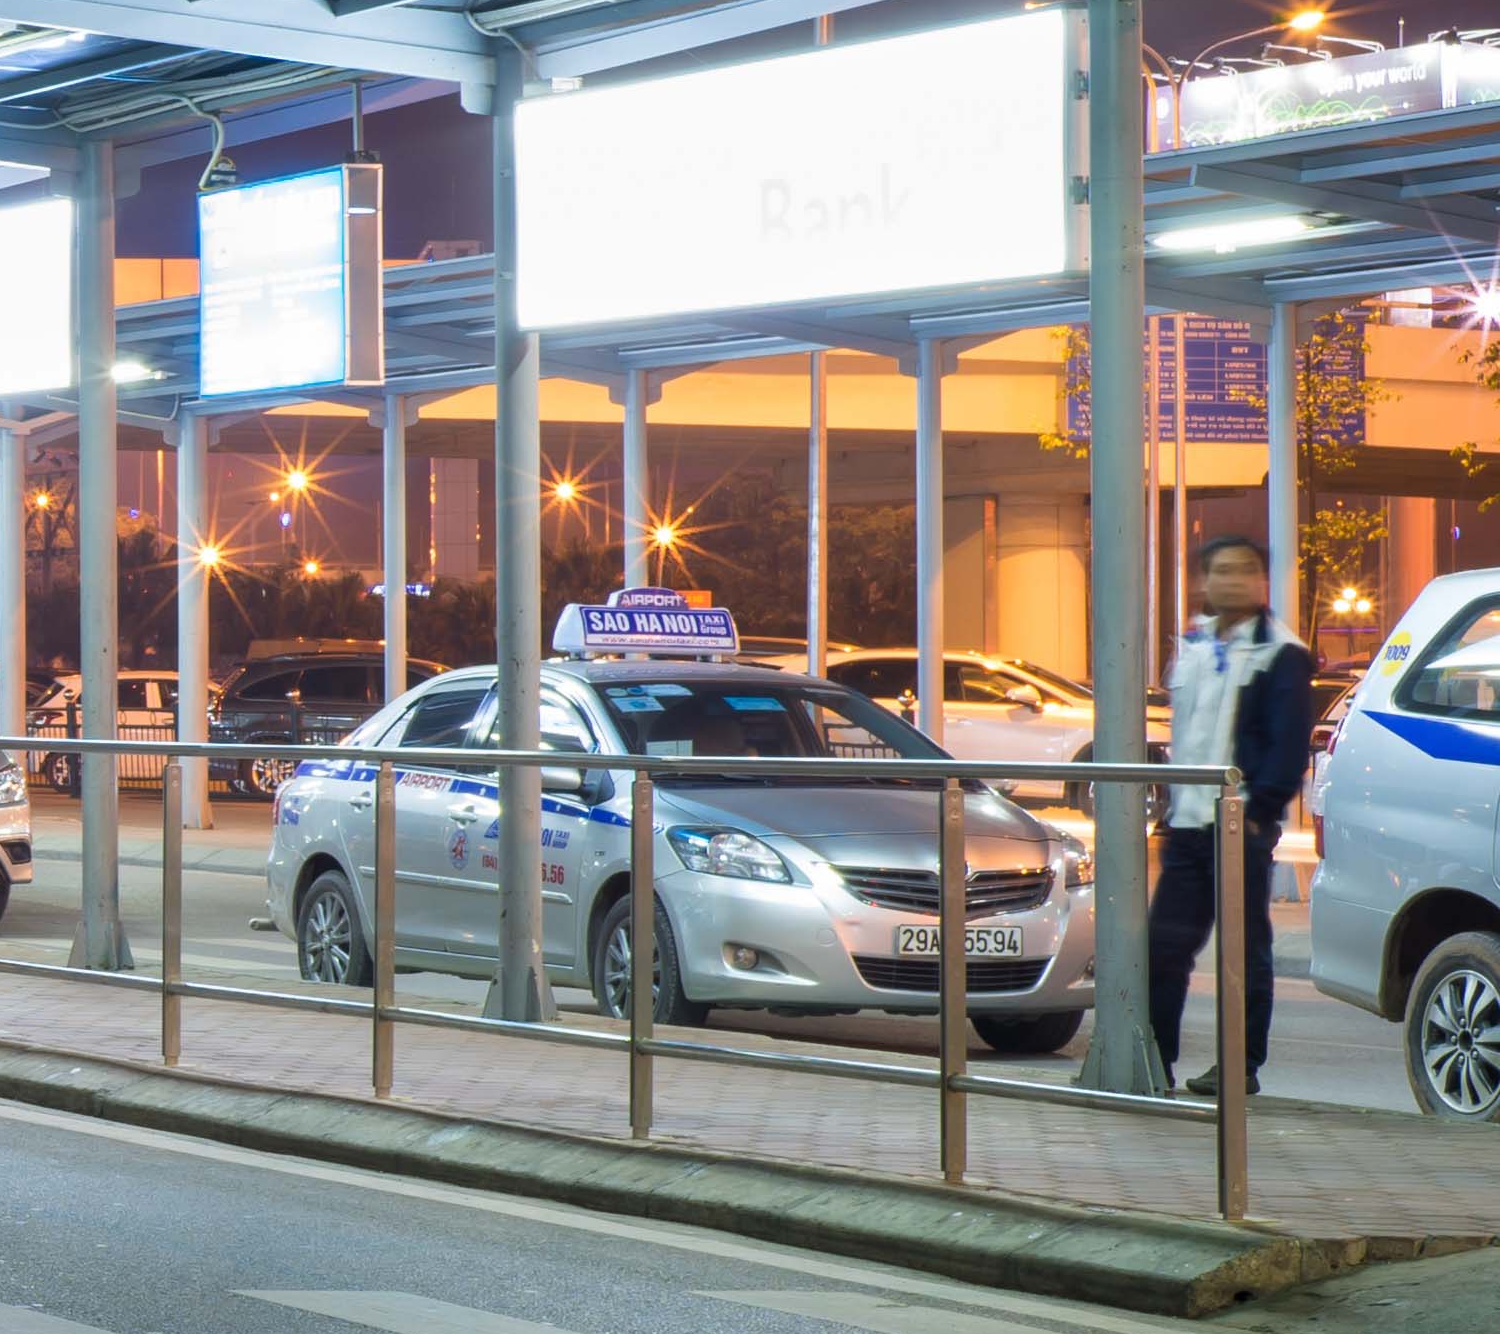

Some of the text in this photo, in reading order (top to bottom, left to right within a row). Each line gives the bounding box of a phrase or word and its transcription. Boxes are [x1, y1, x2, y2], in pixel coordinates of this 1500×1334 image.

[1355, 69, 1387, 93] your
[1388, 63, 1428, 83] world
[621, 594, 684, 607] AIRPORT
[589, 612, 630, 633] SAO
[700, 616, 725, 625] TAXI
[701, 624, 727, 636] Group
[399, 771, 450, 790] AIRPORT
[902, 928, 1019, 954] 29A55.94
